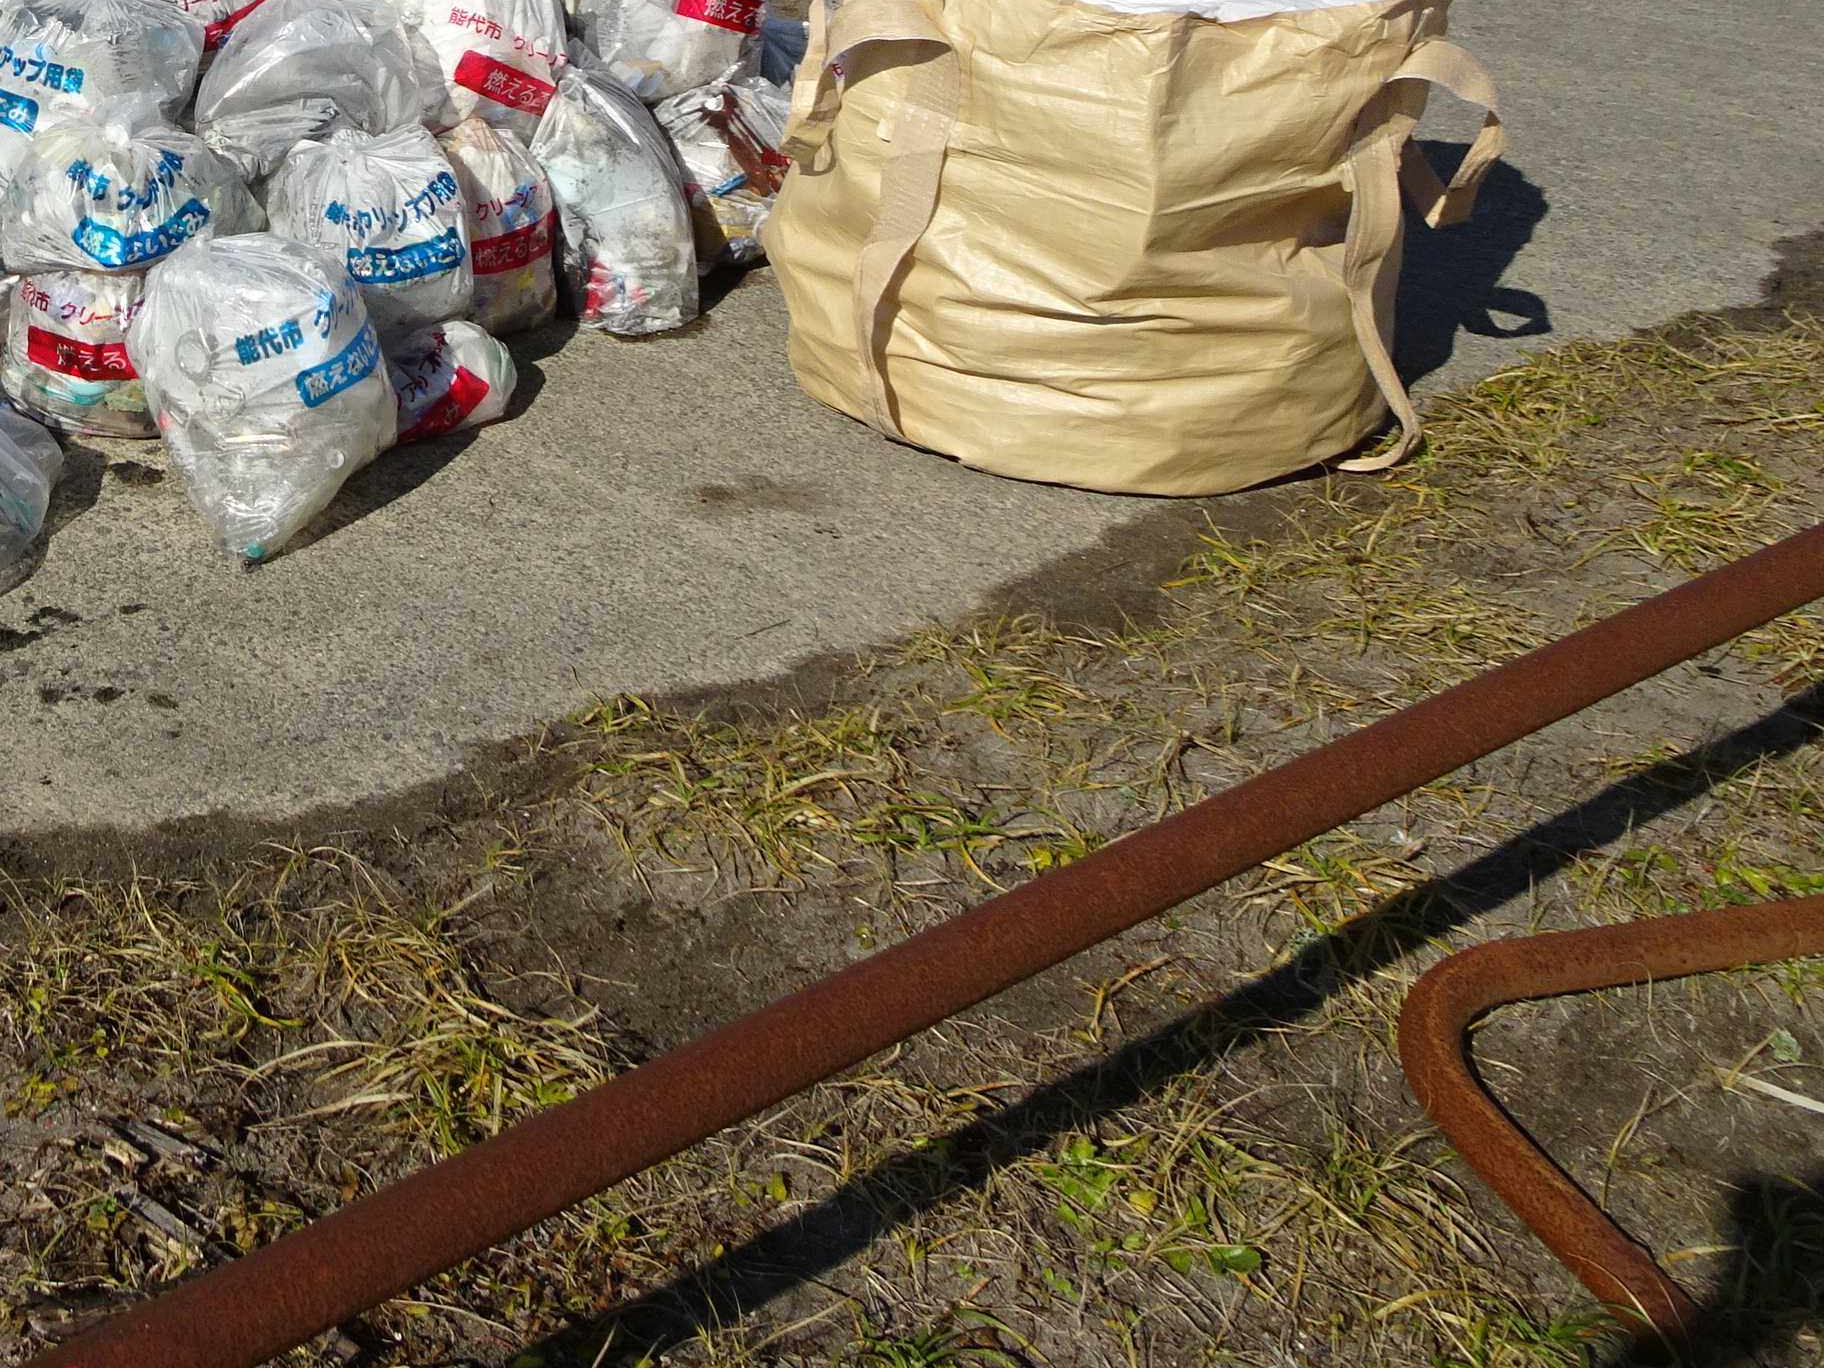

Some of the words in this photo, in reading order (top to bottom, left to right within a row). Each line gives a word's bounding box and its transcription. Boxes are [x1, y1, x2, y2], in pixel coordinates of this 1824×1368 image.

[448, 6, 503, 40] 能代市
[235, 319, 304, 366] 能代市
